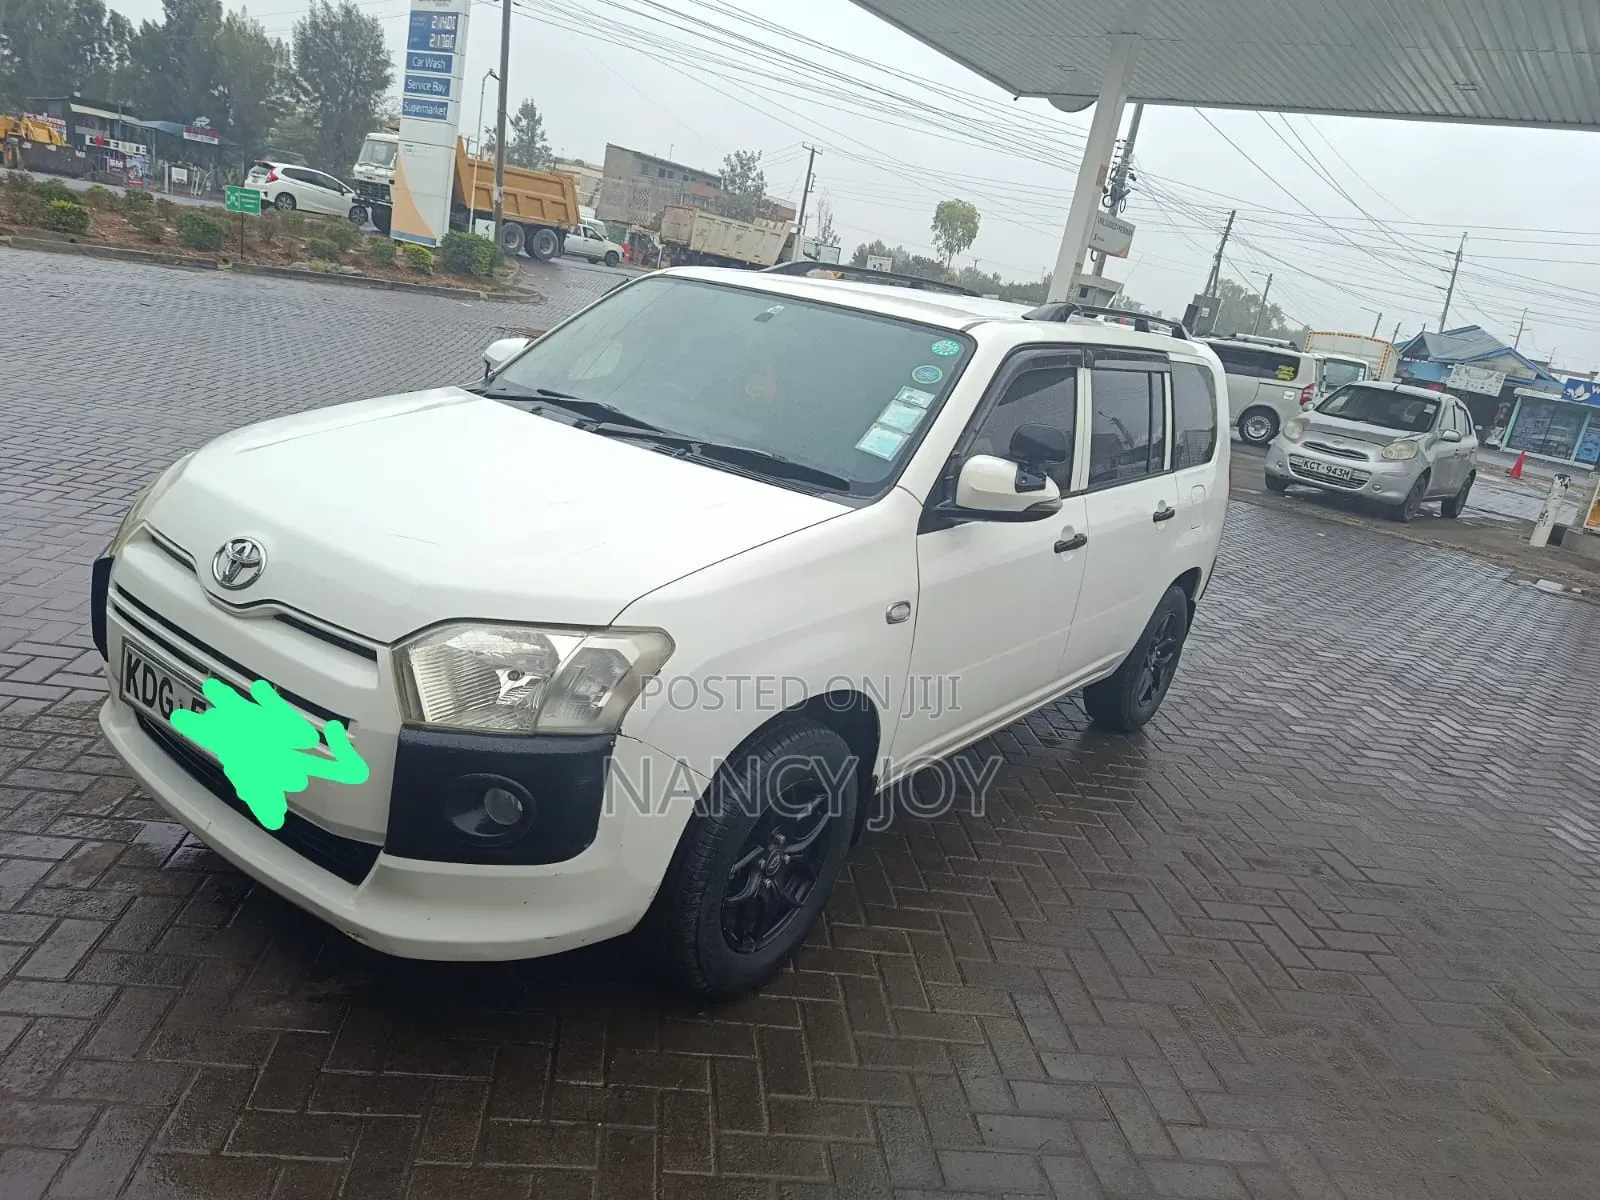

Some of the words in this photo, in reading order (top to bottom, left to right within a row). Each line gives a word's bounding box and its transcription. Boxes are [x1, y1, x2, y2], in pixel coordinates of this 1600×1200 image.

[412, 56, 424, 67] Car
[425, 58, 446, 69] Wash
[407, 79, 431, 91] Service
[432, 81, 447, 94] Bay
[403, 102, 447, 116] Supermarket
[1303, 459, 1321, 471] KCT
[1326, 465, 1351, 478] 943M
[126, 651, 173, 720] KDG
